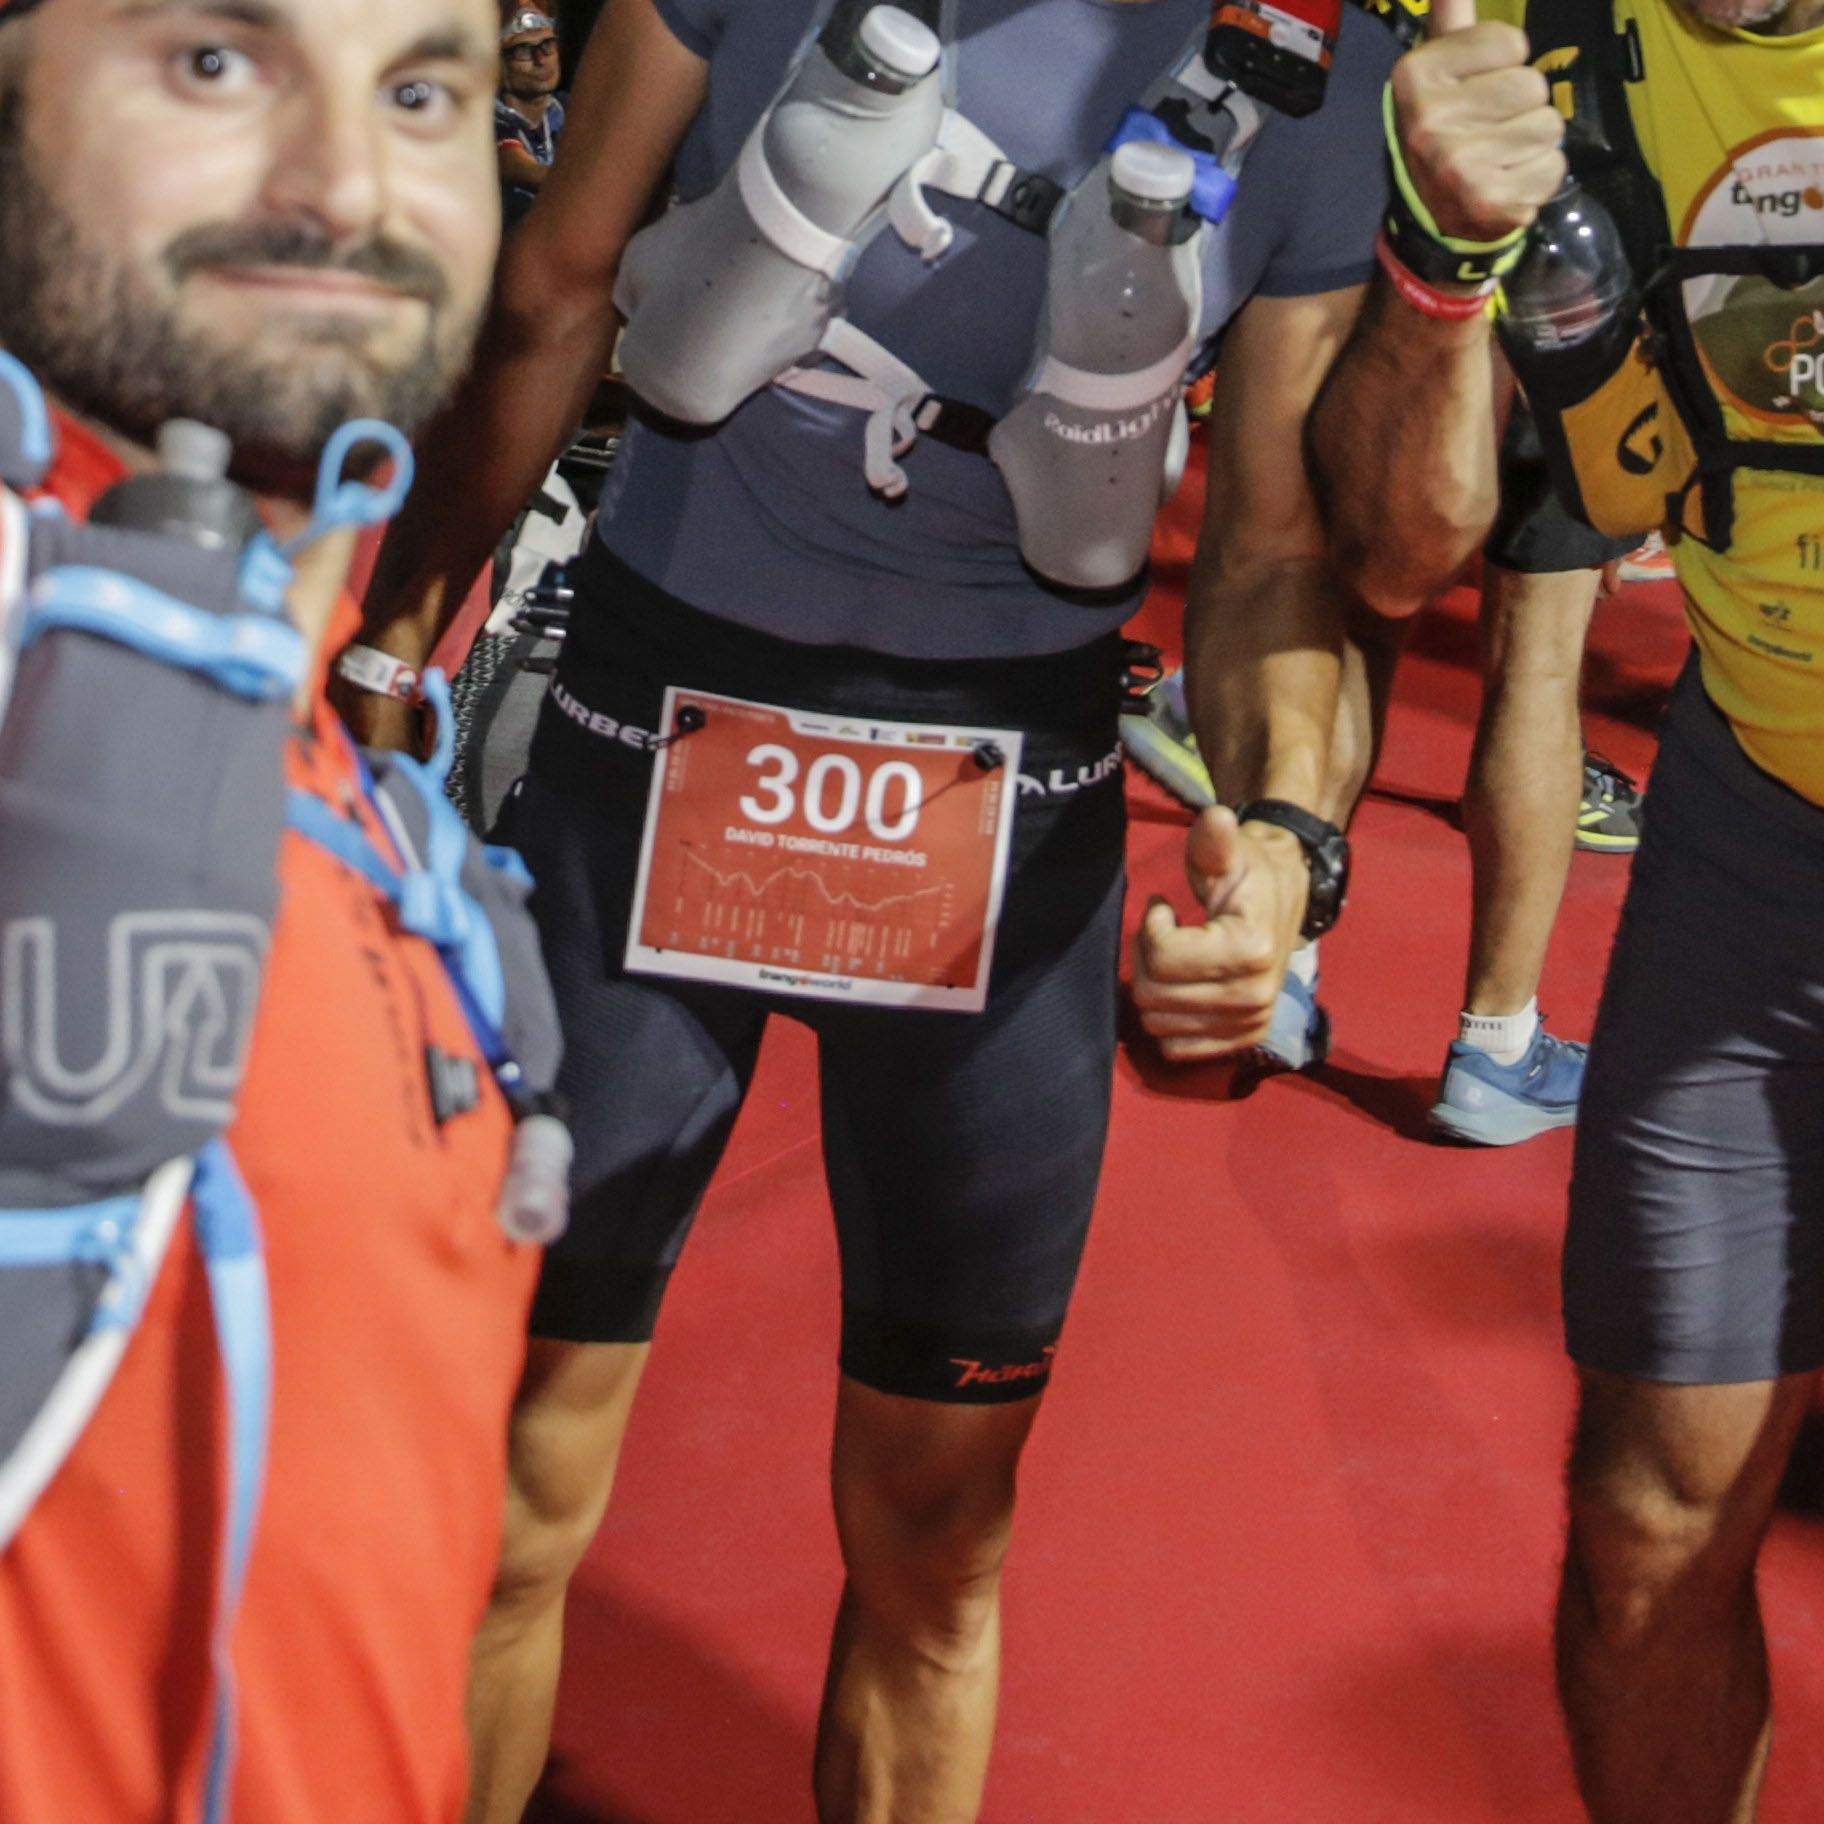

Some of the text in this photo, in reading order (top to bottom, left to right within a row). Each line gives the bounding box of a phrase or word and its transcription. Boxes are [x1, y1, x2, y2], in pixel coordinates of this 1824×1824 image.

[740, 743, 924, 841] 300
[725, 826, 928, 867] DAVID TORRENTE PEDRÓS
